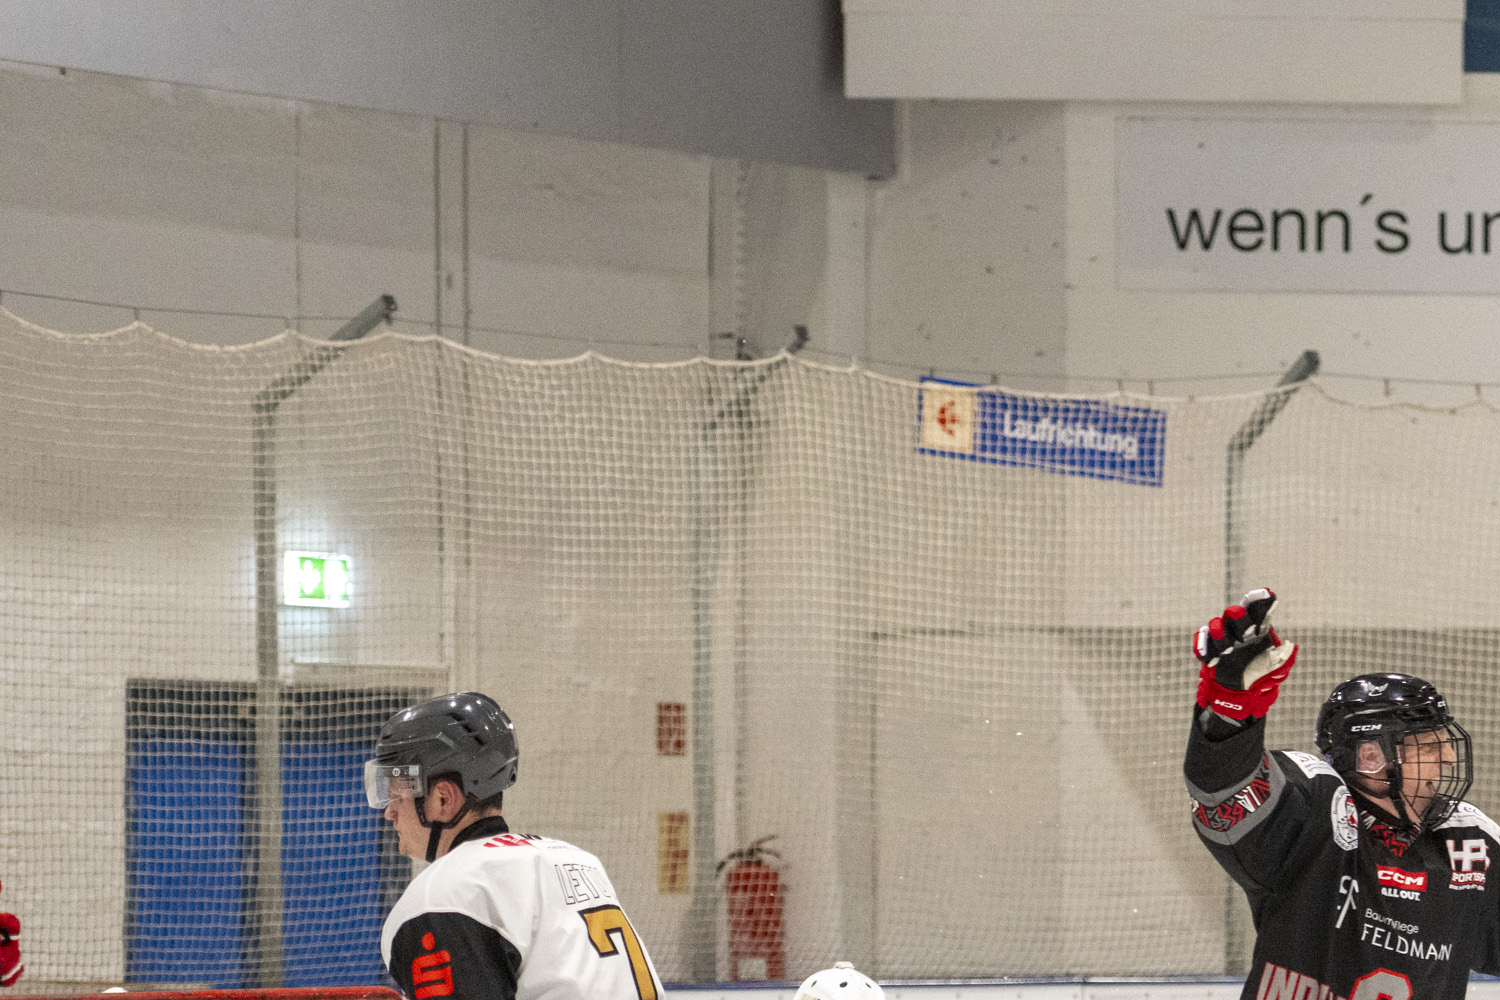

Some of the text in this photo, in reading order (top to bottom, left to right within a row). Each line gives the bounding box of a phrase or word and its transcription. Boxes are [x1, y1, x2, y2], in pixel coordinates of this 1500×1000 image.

[1350, 723, 1382, 733] CCM
[1378, 869, 1425, 886] CCM
[1381, 887, 1421, 902] ALL OUT
